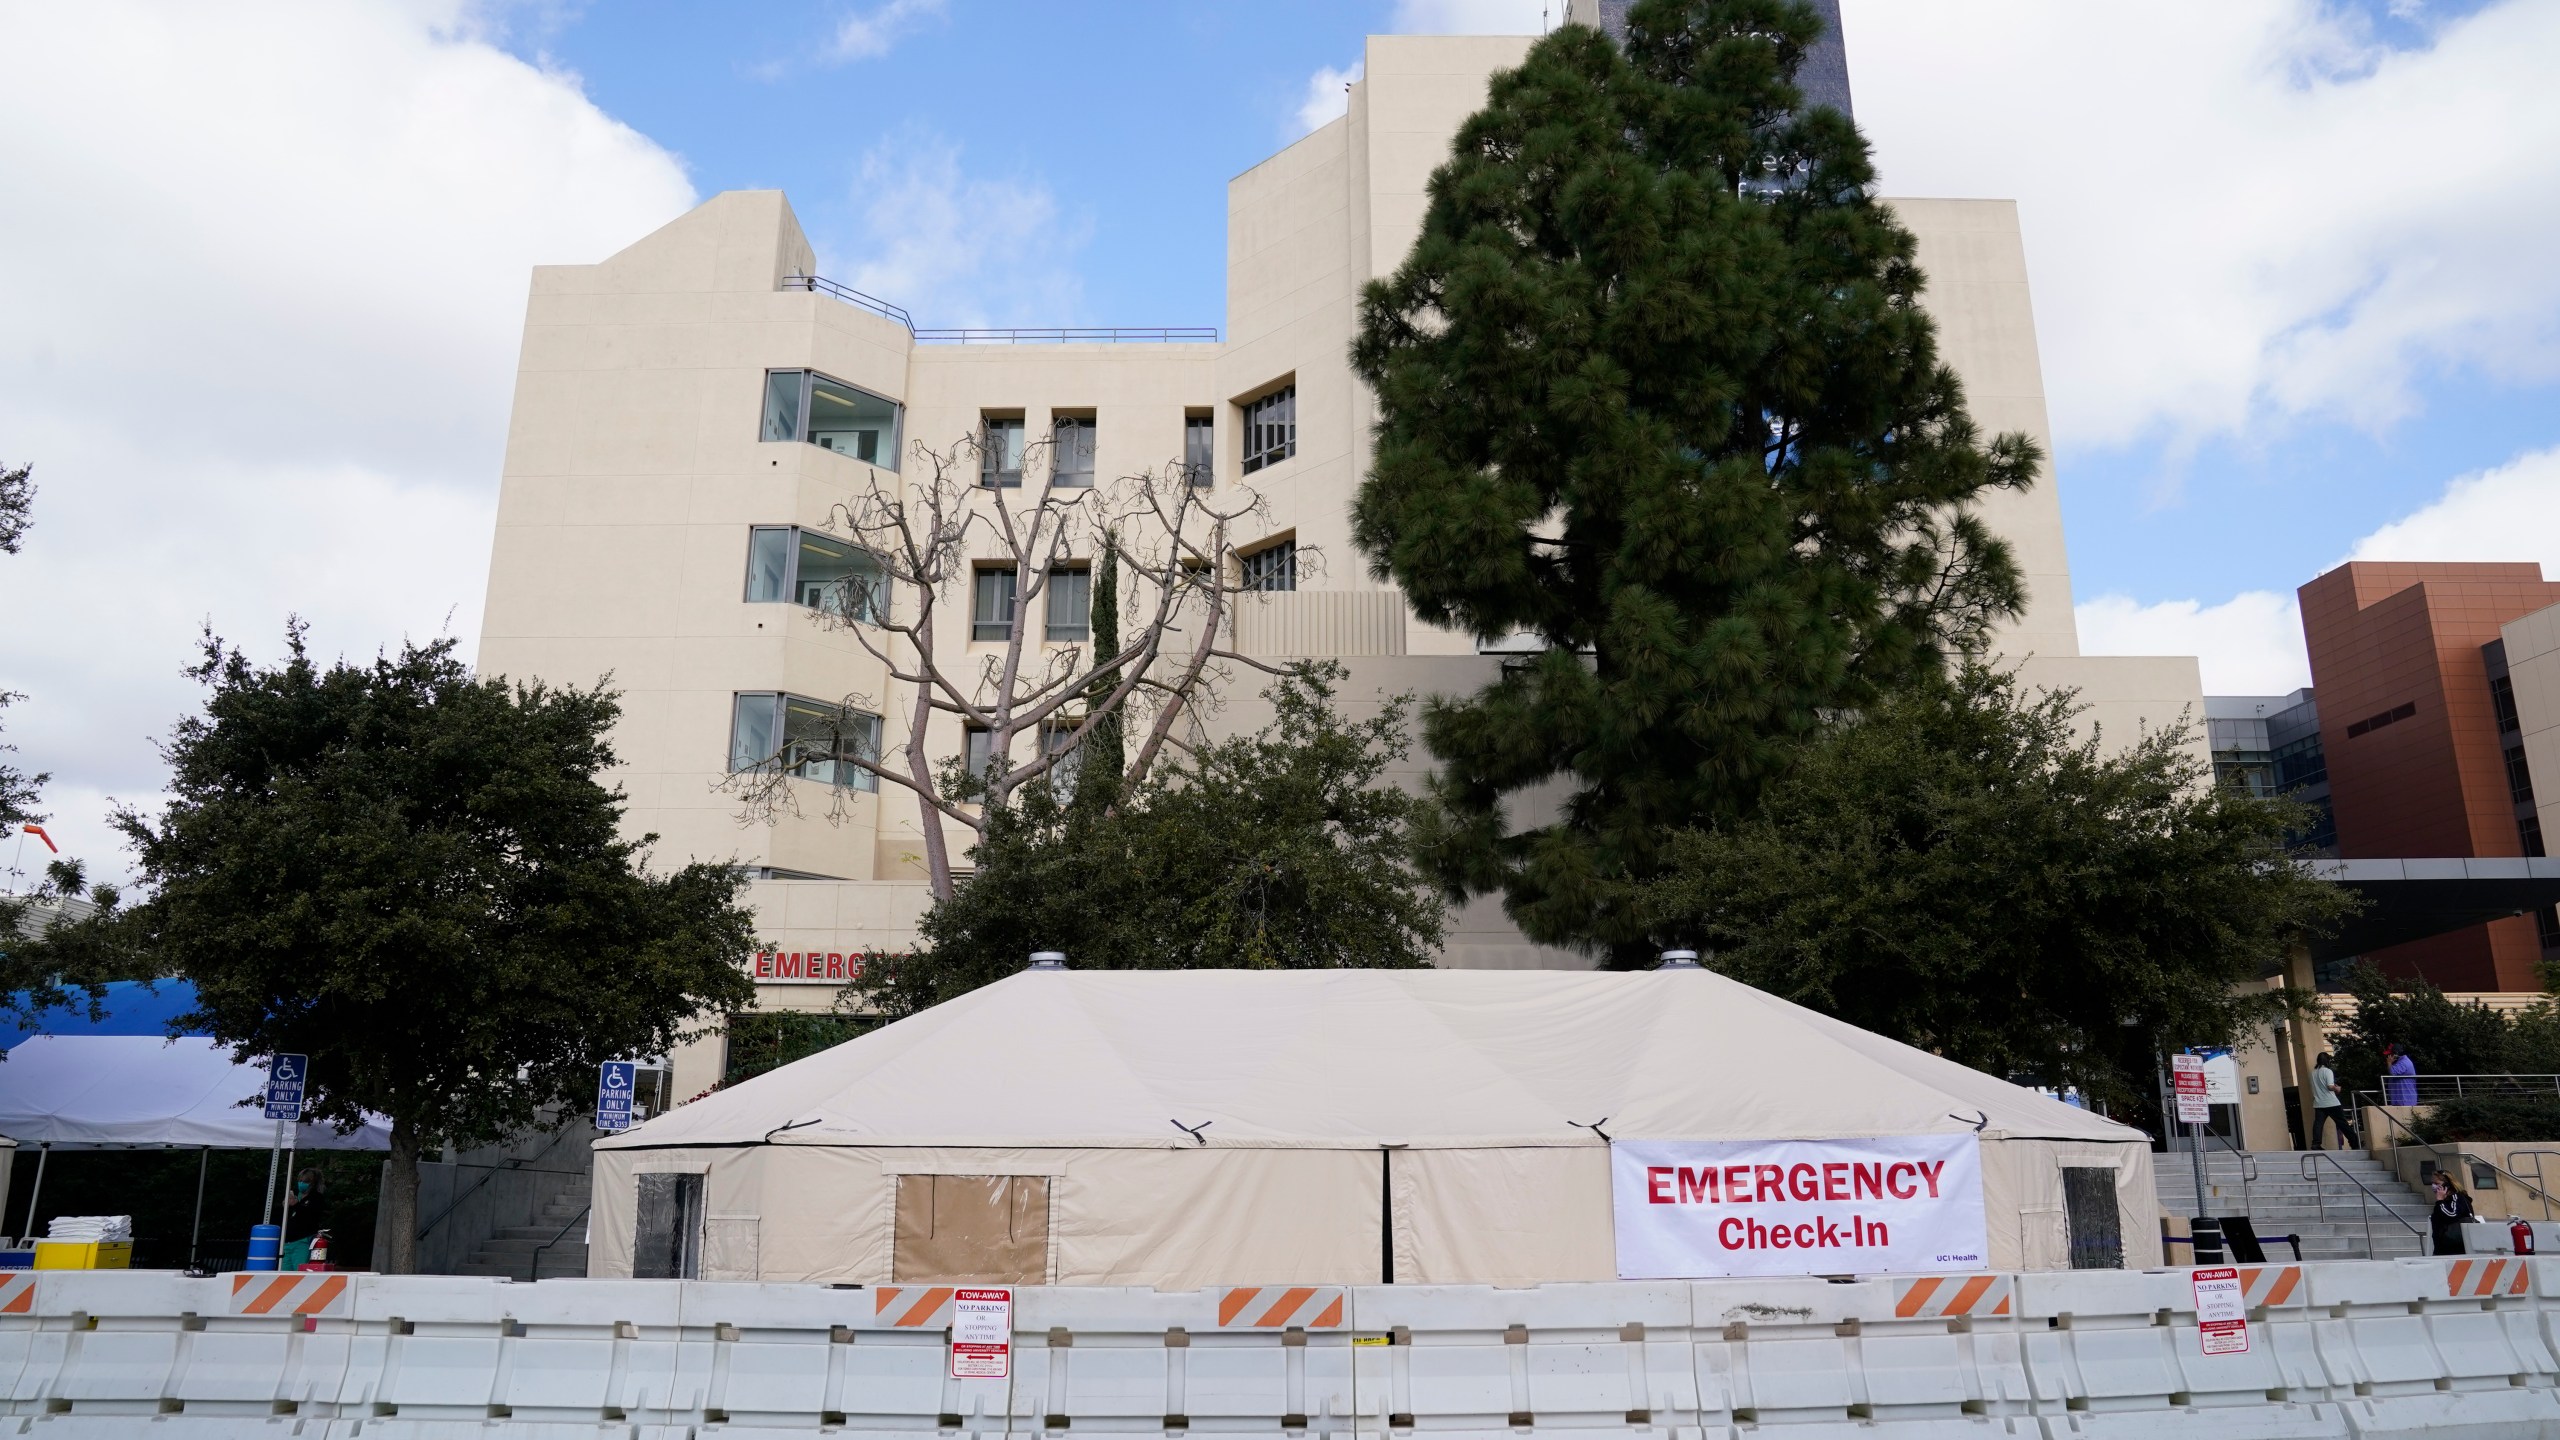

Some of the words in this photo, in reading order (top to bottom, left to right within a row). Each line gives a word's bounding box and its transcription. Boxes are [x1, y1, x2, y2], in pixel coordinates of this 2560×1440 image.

[270, 1080, 302, 1091] PARKING
[274, 1091, 295, 1101] ONLY
[601, 1089, 631, 1100] PARKING
[606, 1100, 625, 1110] ONLY
[1647, 1160, 1945, 1204] EMERGENCY
[1718, 1215, 1889, 1250] Check-In
[2196, 1270, 2233, 1279] TOW-AWAY
[961, 1291, 1005, 1299] TOW-AWAY
